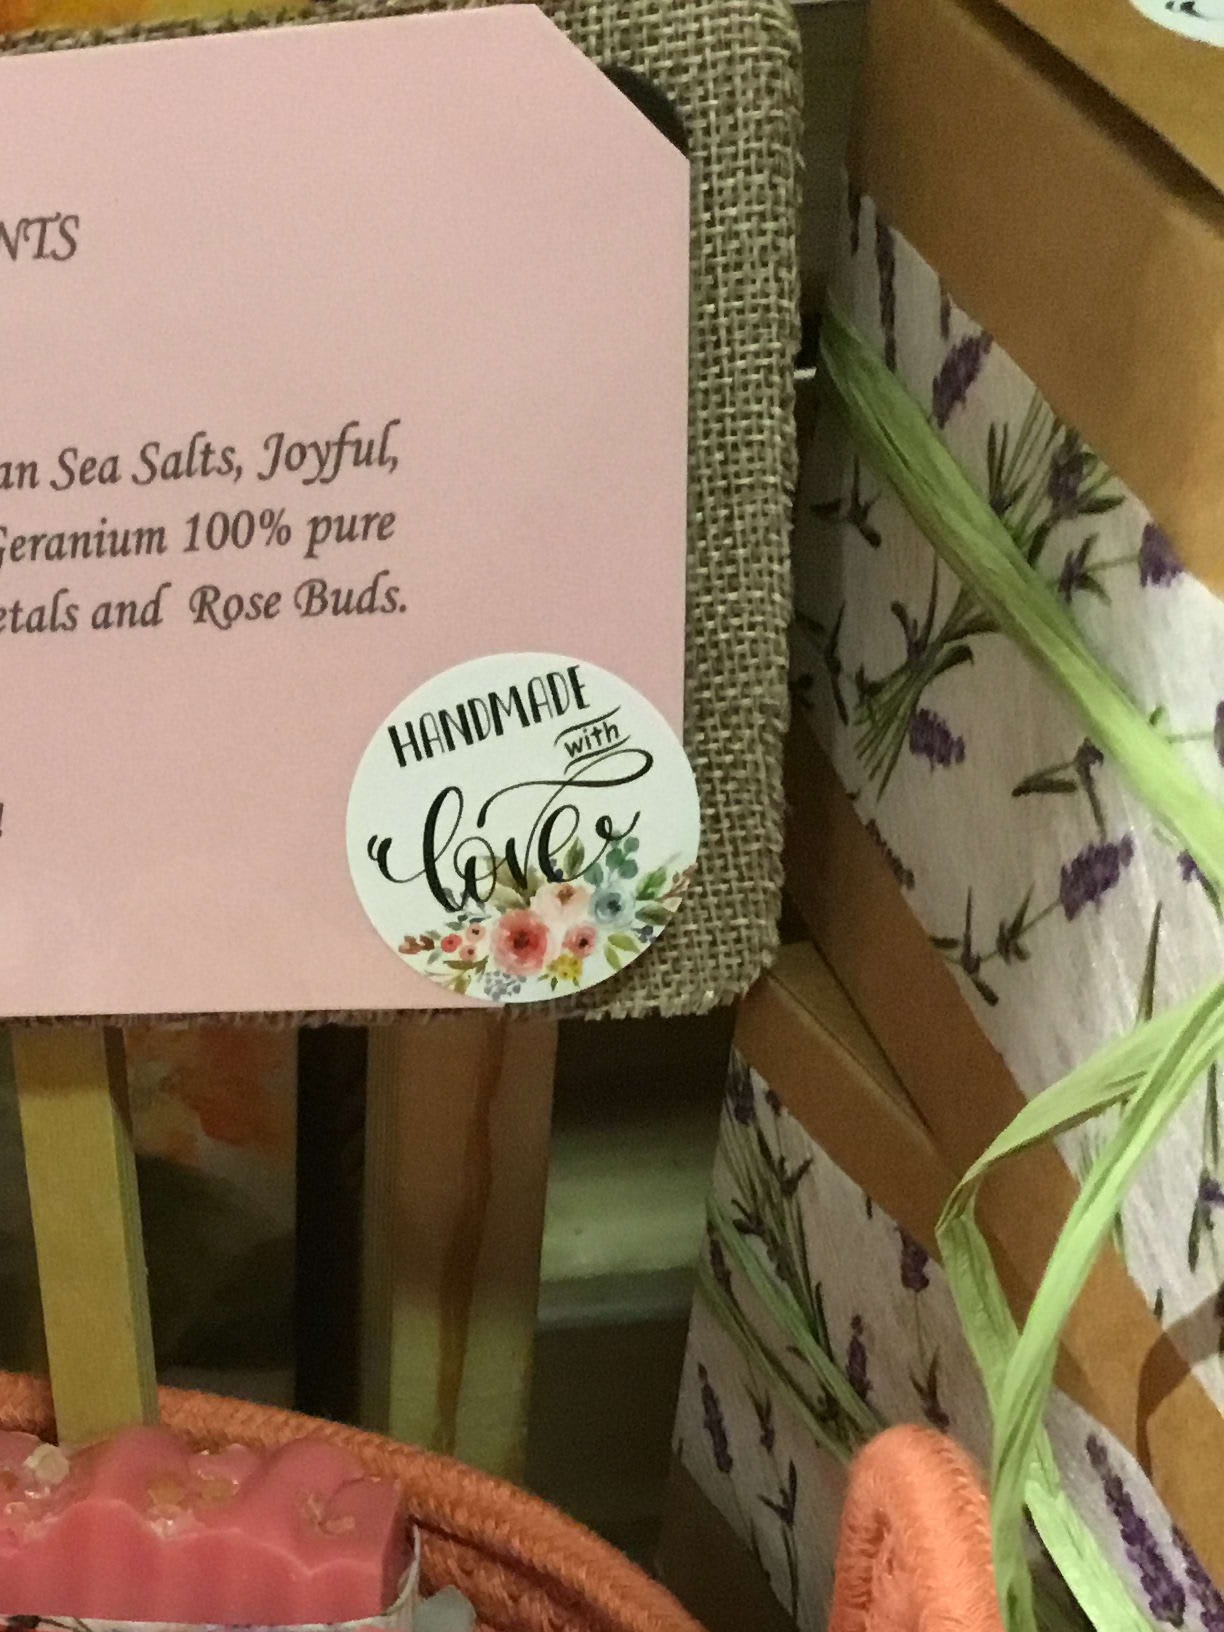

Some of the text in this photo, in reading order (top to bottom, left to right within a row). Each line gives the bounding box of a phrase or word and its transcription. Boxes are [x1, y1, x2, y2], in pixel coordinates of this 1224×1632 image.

[49, 446, 122, 492] Sea
[130, 432, 244, 486] Salts,
[256, 417, 402, 487] Joyful,
[182, 507, 292, 553] 100%
[303, 511, 397, 560] pure
[90, 581, 173, 631] and
[188, 583, 283, 631] Rose
[293, 569, 408, 619] Buds.
[387, 665, 591, 768] HANDMADE
[563, 720, 620, 758] with
[367, 748, 654, 912] love
